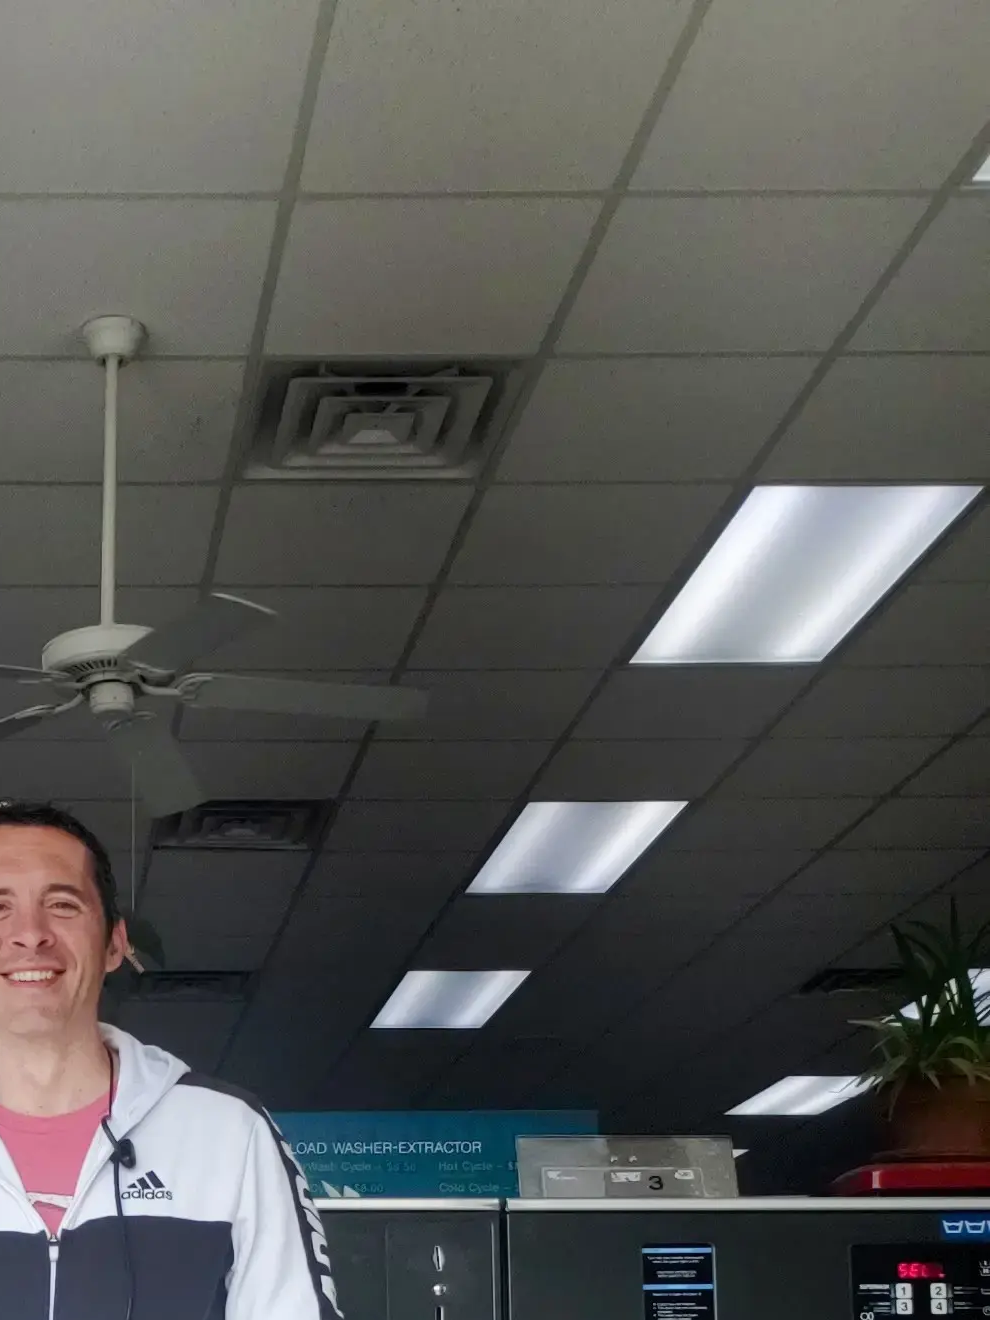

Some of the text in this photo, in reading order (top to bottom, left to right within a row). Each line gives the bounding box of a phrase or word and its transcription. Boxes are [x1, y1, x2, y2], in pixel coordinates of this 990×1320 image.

[290, 1141, 483, 1155] LOAD WASHER-EXTRACTOR
[438, 1161, 493, 1173] Hot Cycle
[439, 1183, 500, 1195] Cold Cycle
[648, 1175, 664, 1191] 3
[121, 1188, 173, 1201] adidas
[900, 1286, 907, 1296] 1
[934, 1286, 943, 1296] 2
[900, 1301, 909, 1312] 3
[934, 1301, 943, 1312] 4
